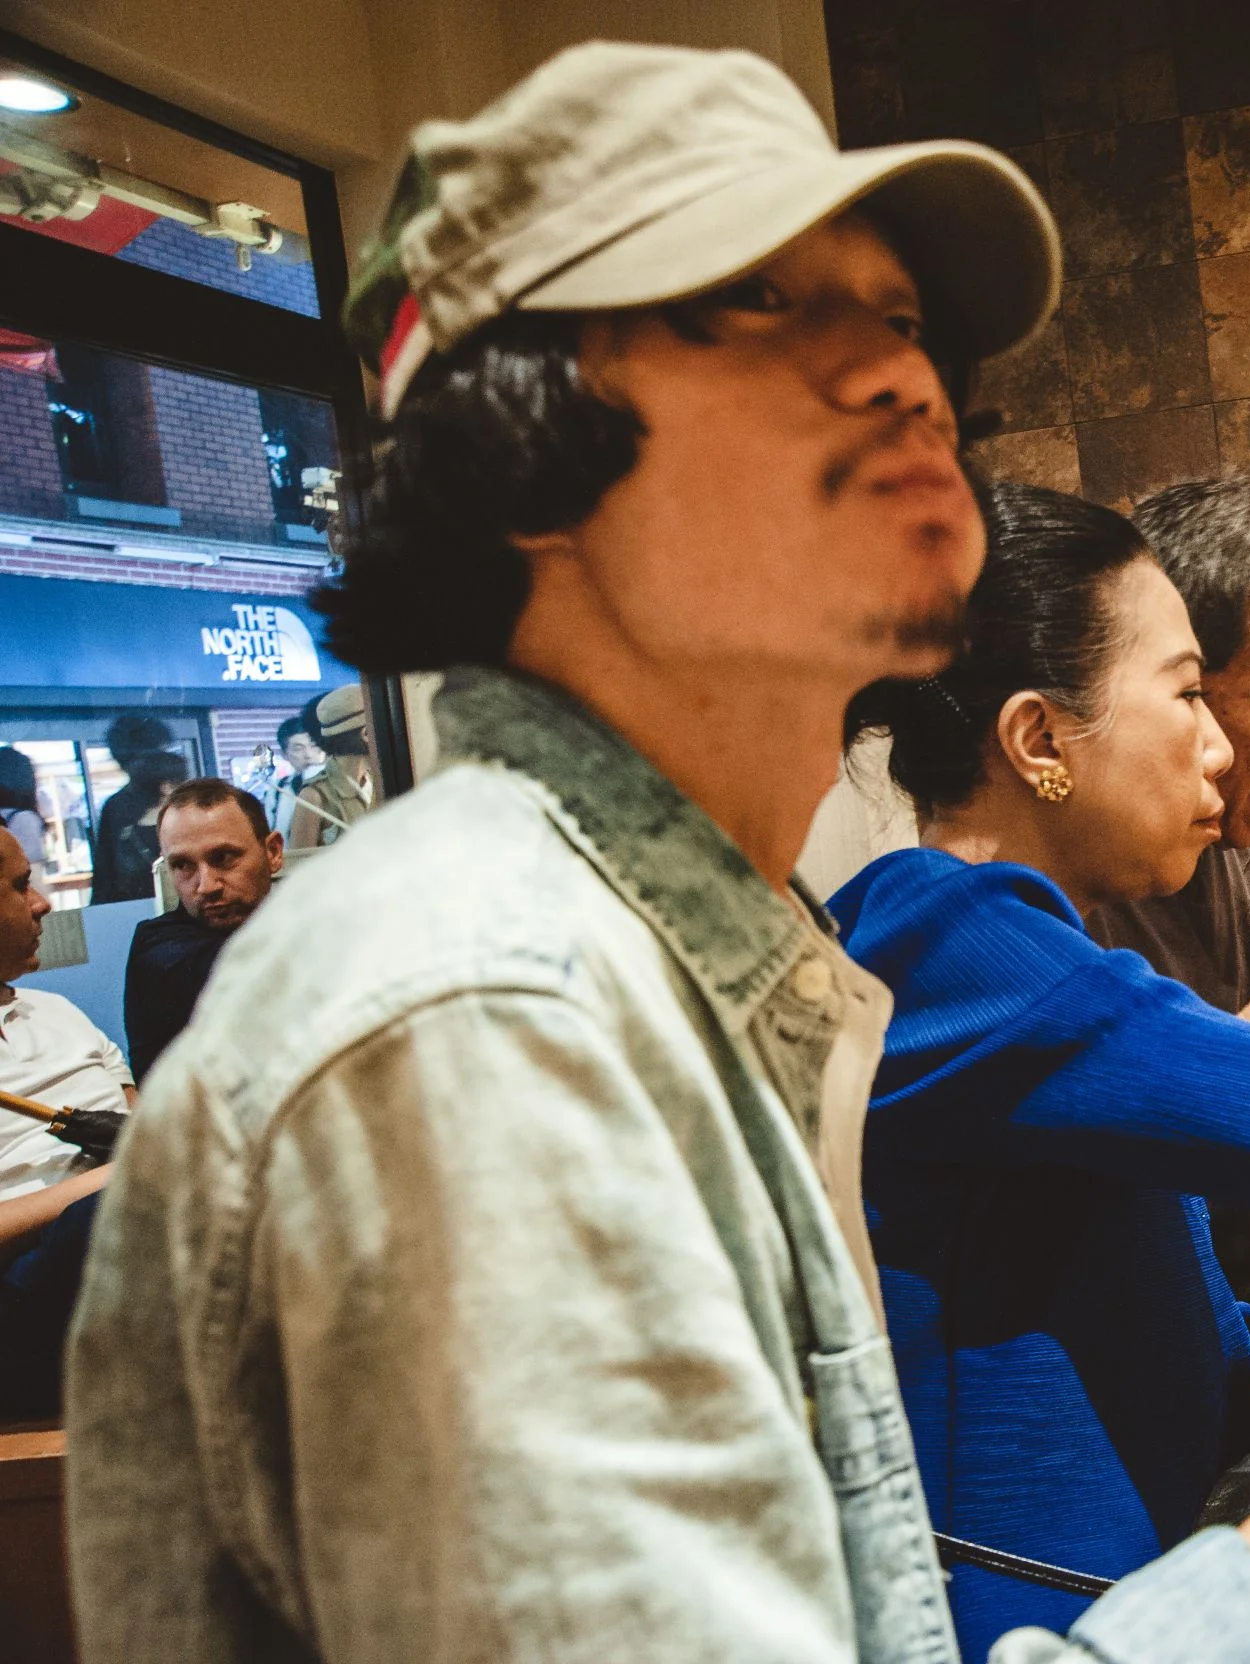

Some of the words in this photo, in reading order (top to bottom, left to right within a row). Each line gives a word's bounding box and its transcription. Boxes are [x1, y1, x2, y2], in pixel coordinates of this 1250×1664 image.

[232, 603, 277, 631] THE
[201, 627, 281, 655] NORTH
[223, 655, 283, 681] FACE
